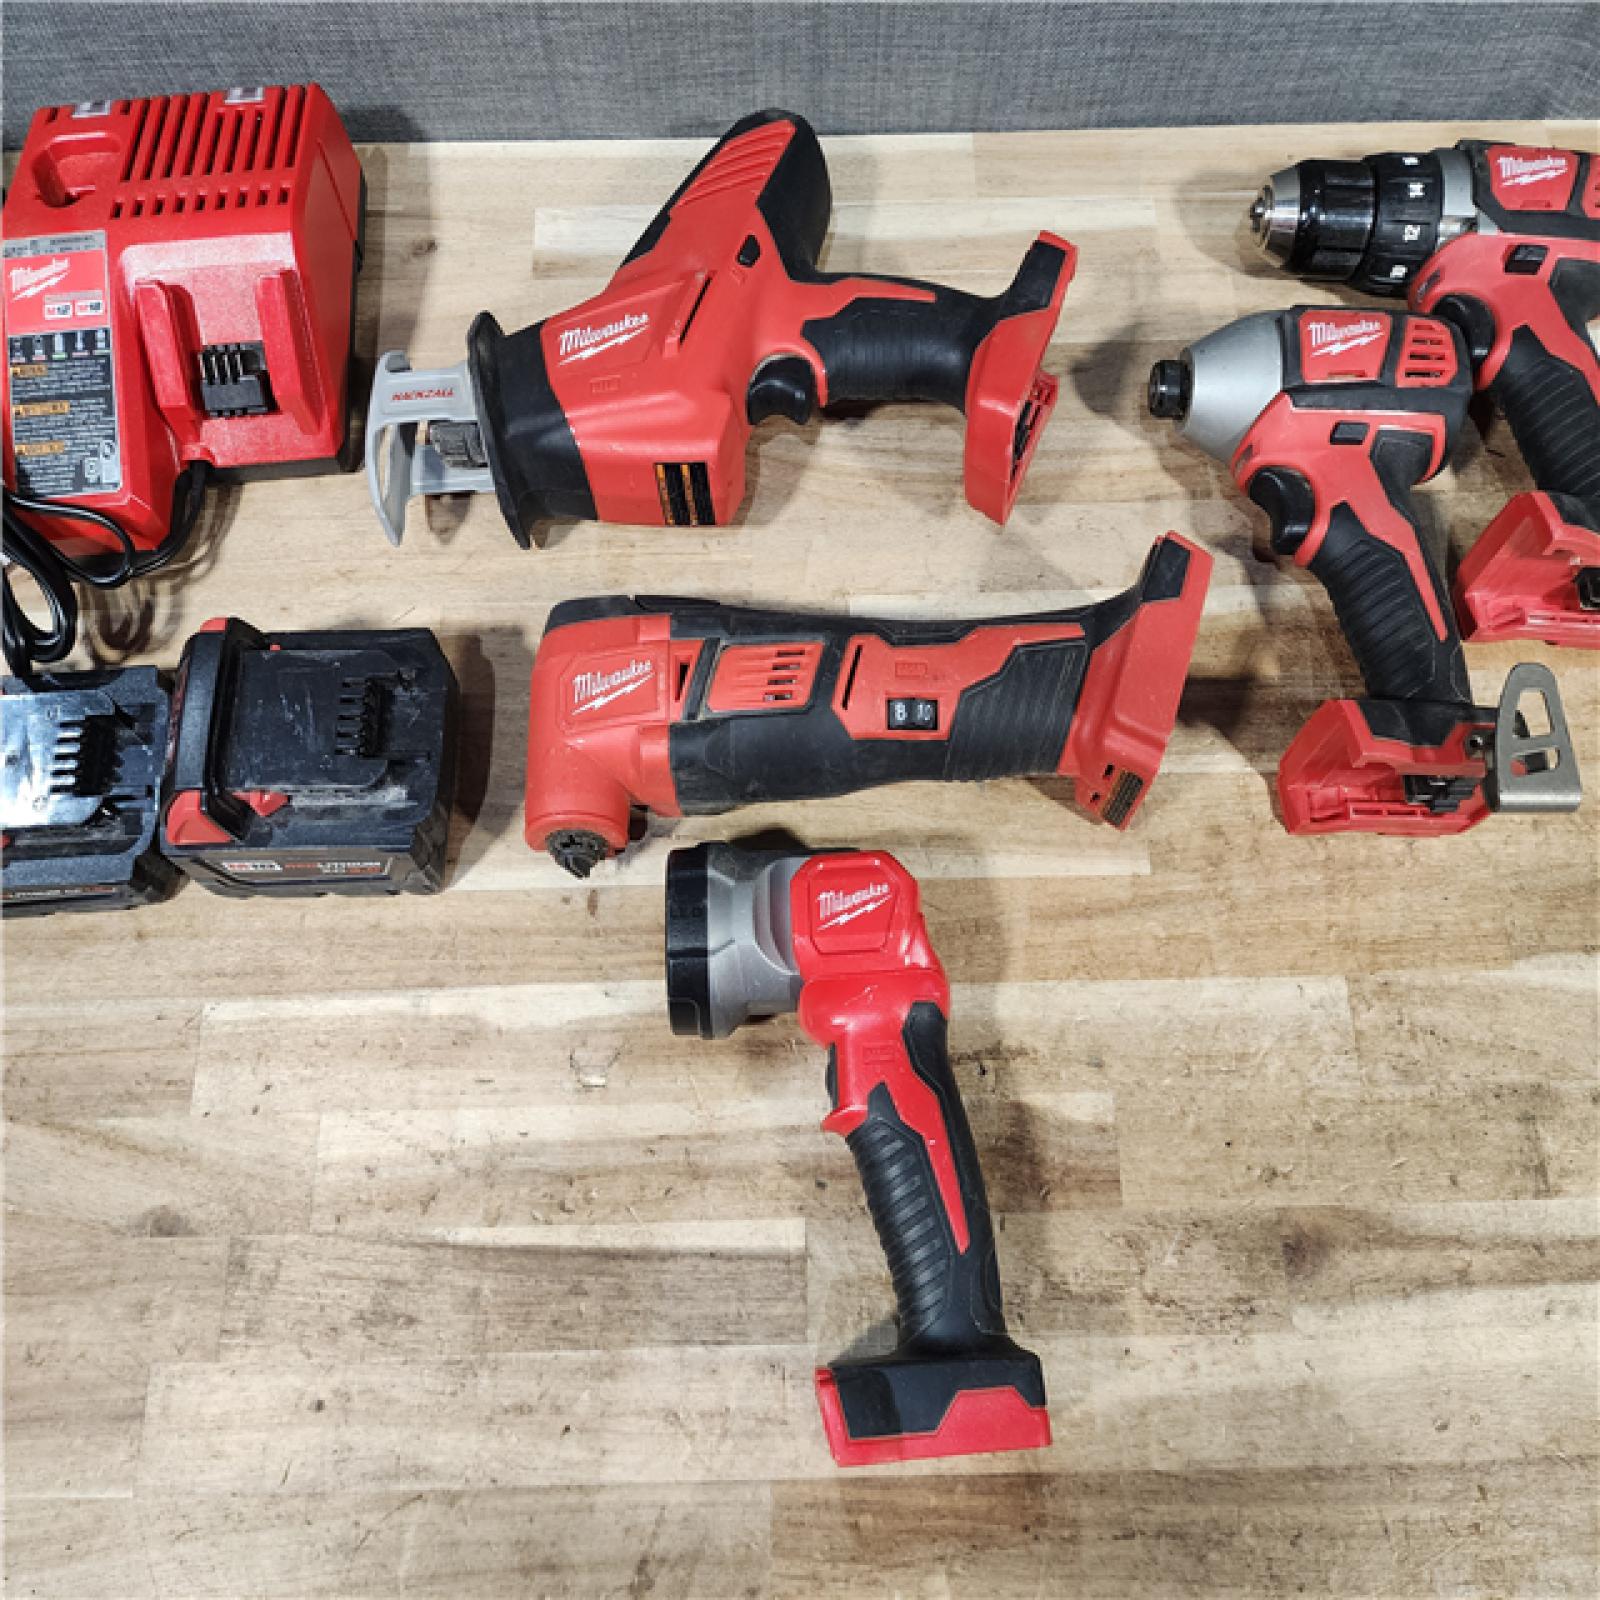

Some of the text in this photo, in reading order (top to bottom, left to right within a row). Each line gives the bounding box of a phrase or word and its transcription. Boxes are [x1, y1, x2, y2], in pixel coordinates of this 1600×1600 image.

[558, 313, 648, 355] Milwaukee
[1308, 320, 1382, 347] Milwaukee
[573, 659, 652, 704] Milwaukee
[816, 883, 889, 920] Milwaukee
